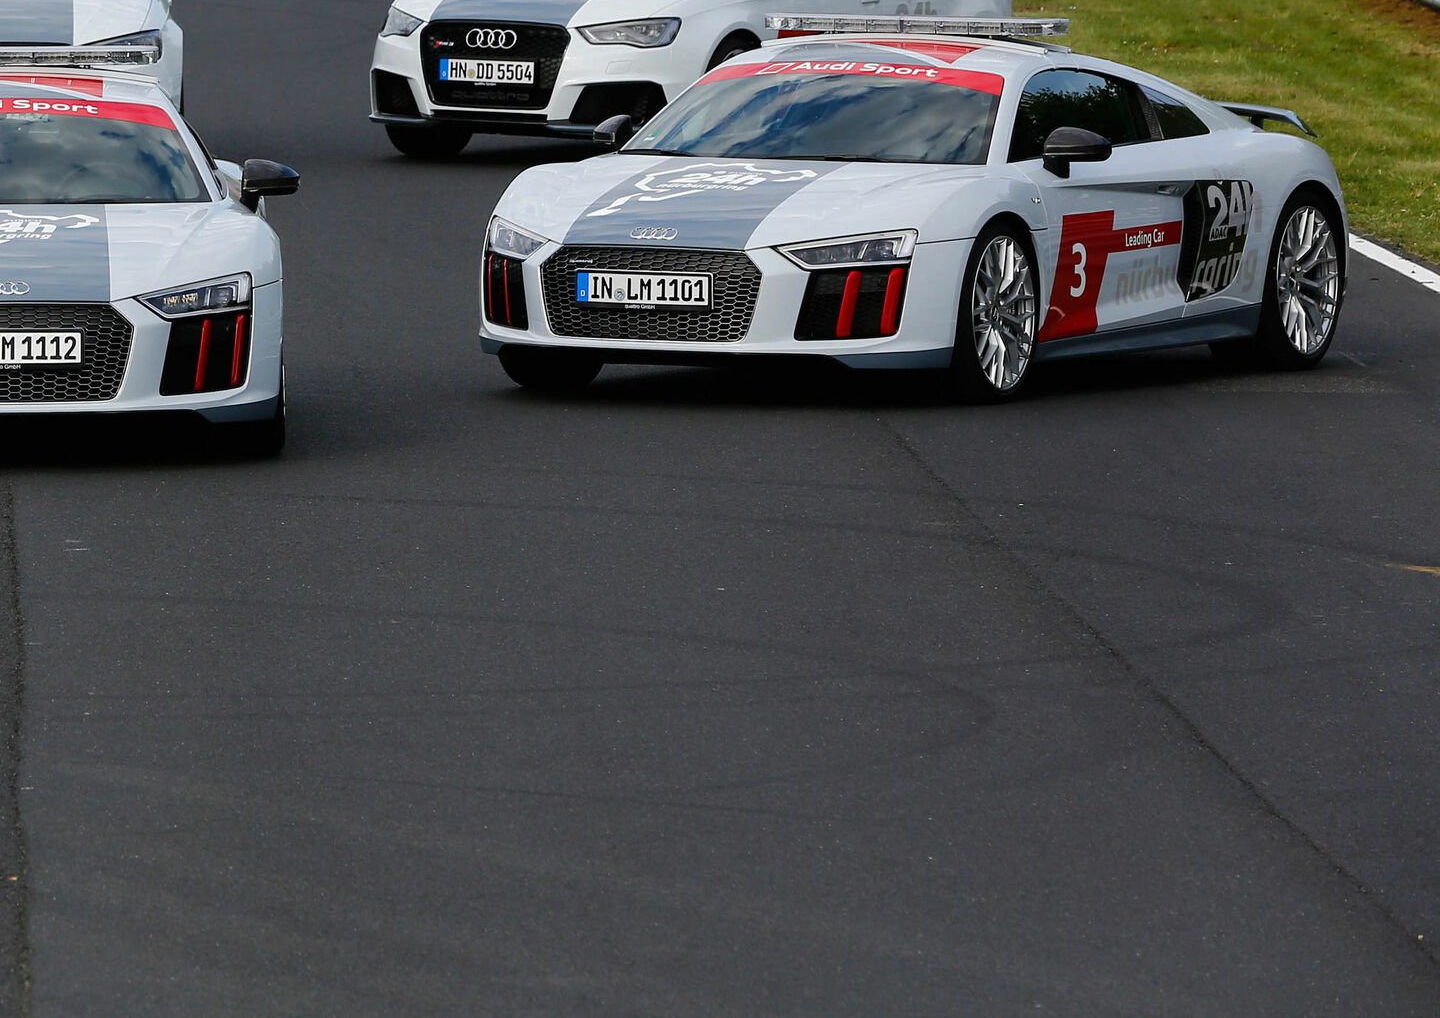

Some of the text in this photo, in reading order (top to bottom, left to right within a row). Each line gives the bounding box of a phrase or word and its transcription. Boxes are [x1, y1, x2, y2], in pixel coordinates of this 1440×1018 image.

[450, 62, 467, 78] HN
[477, 63, 494, 80] DD
[497, 64, 532, 82] 5504
[792, 62, 939, 78] Audi Sport
[12, 99, 99, 114] Sport
[1125, 228, 1165, 248] Leading Car
[1070, 242, 1087, 298] 3
[591, 276, 612, 299] IN
